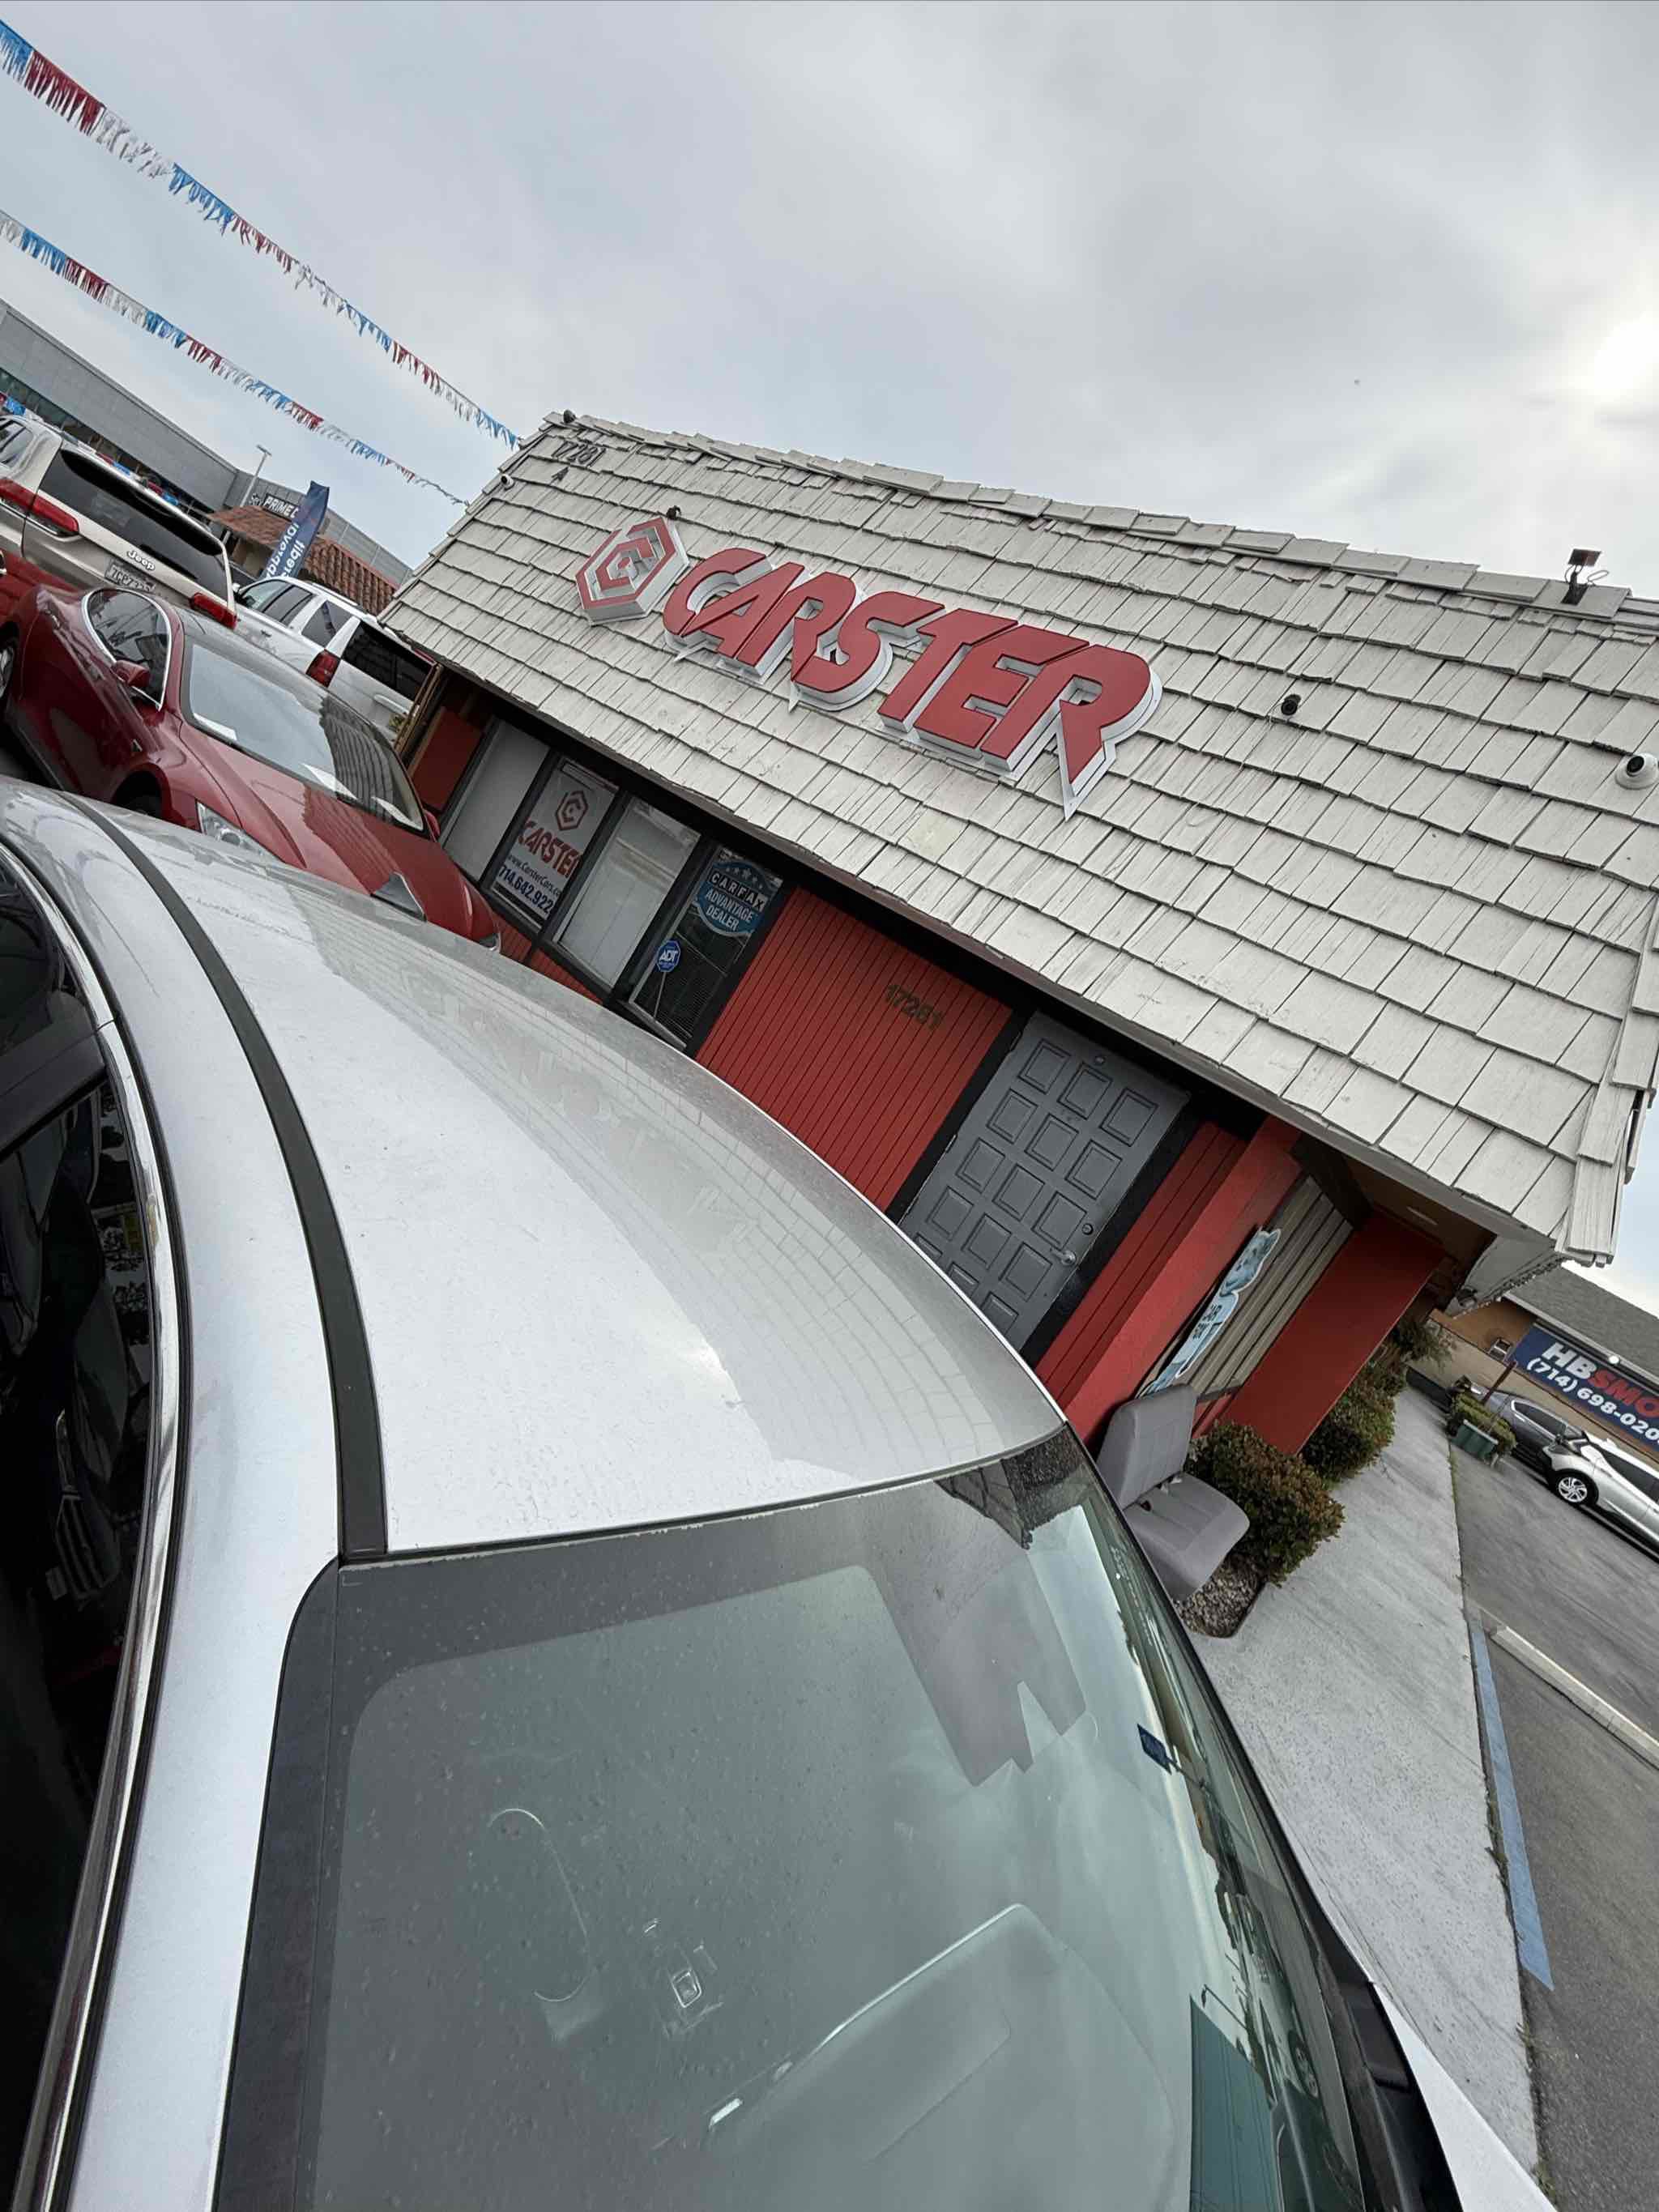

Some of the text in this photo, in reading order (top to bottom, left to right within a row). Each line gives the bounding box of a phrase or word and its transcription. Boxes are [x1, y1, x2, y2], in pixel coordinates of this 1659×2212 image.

[126, 551, 156, 571] Jeep
[663, 548, 1162, 820] CARSTER
[705, 890, 753, 923] ADVANTAGE
[710, 872, 768, 912] CARFAX
[706, 905, 740, 931] DEALER
[659, 950, 678, 962] ADT
[1527, 1358, 1659, 1446] (714) 698-020
